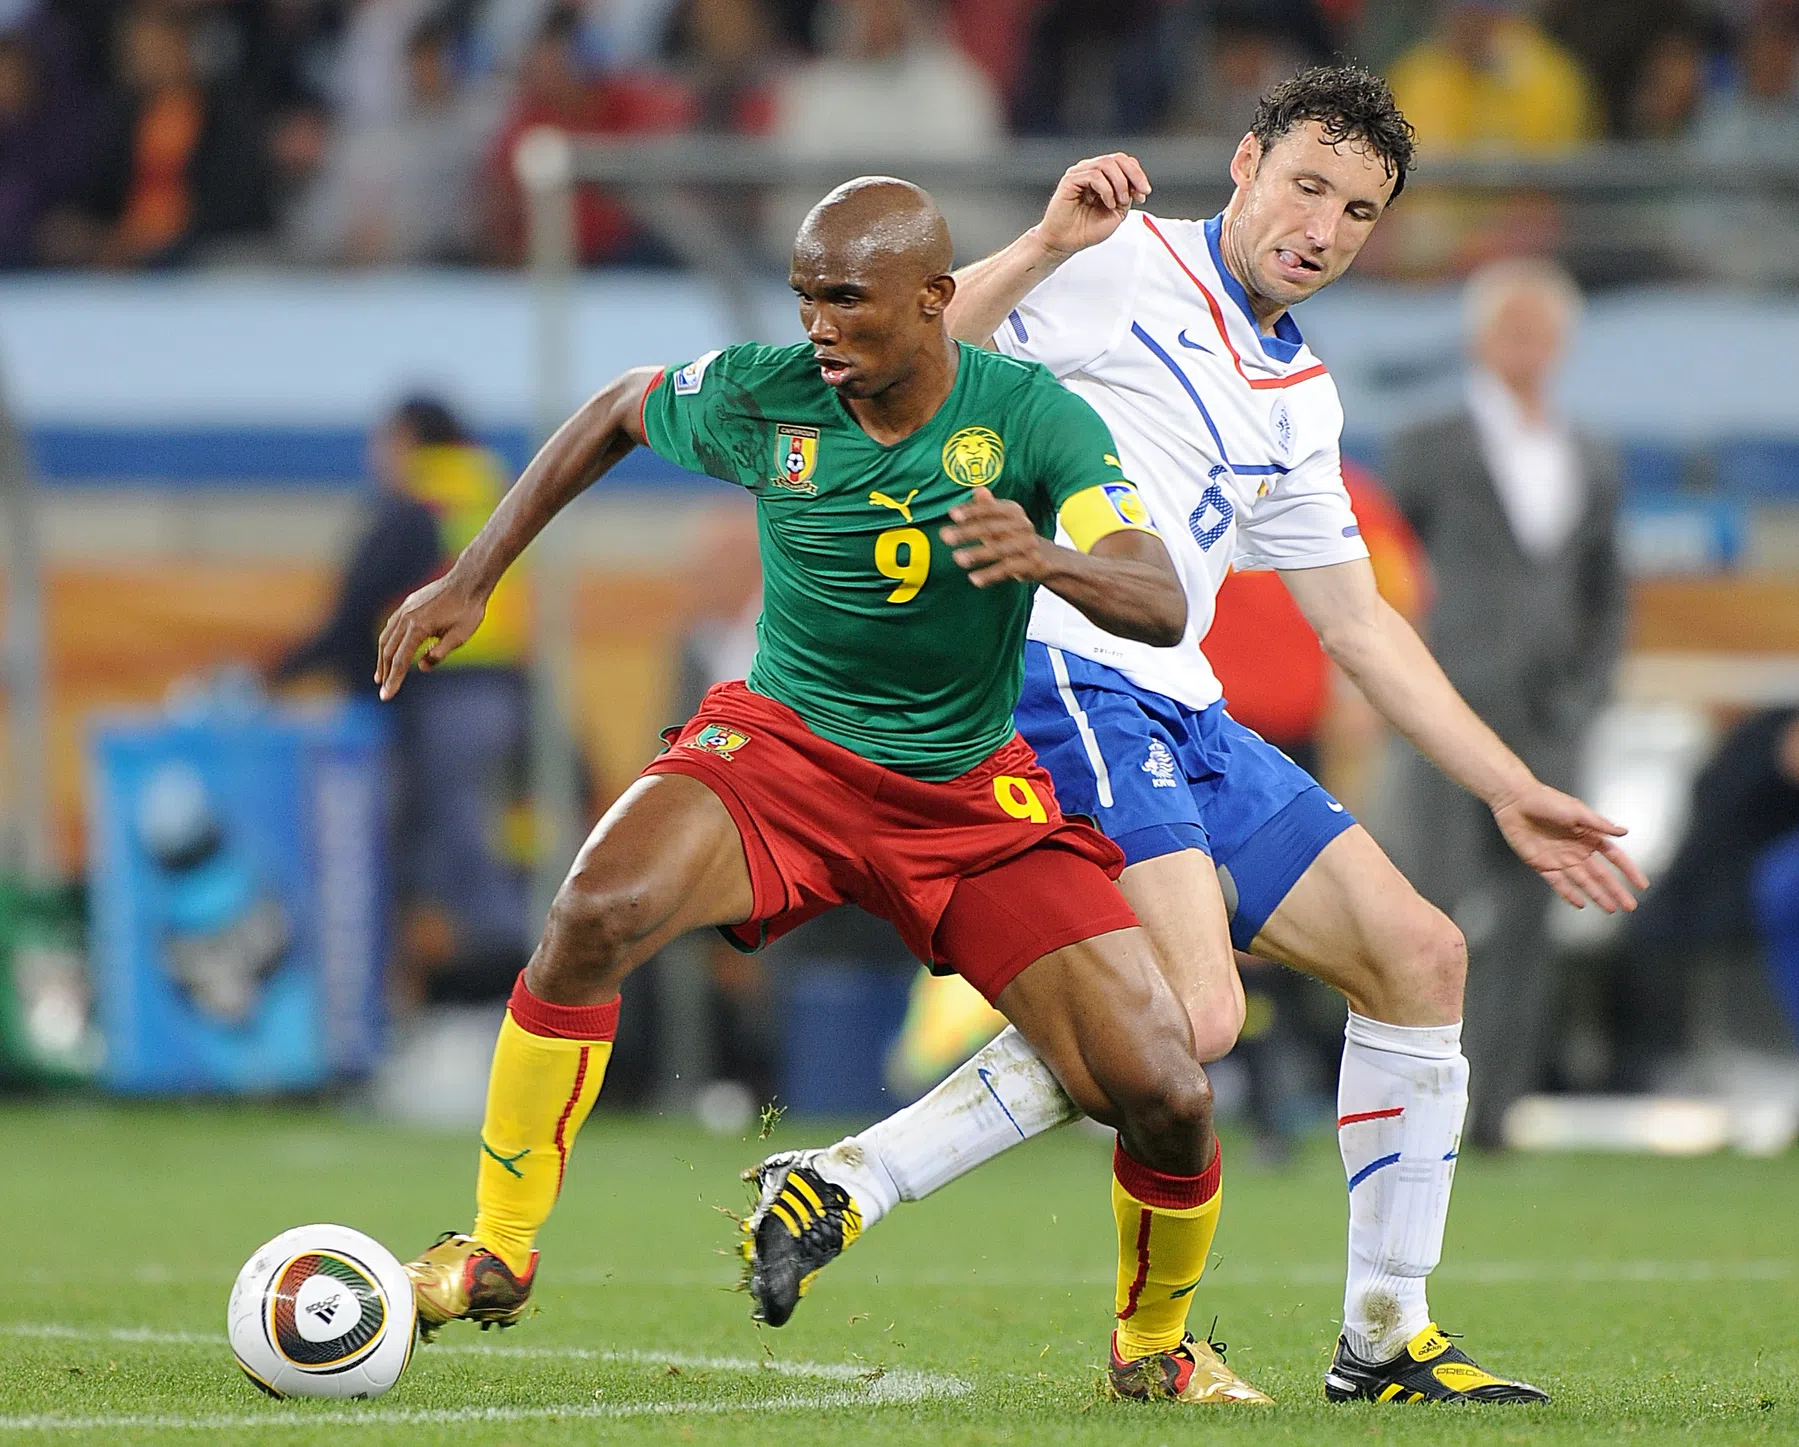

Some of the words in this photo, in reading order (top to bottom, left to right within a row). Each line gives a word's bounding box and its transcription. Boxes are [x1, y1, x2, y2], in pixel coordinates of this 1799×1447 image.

[1189, 464, 1234, 553] 6
[874, 527, 931, 604] 9
[992, 775, 1048, 824] 9
[1418, 1344, 1442, 1356] adidas
